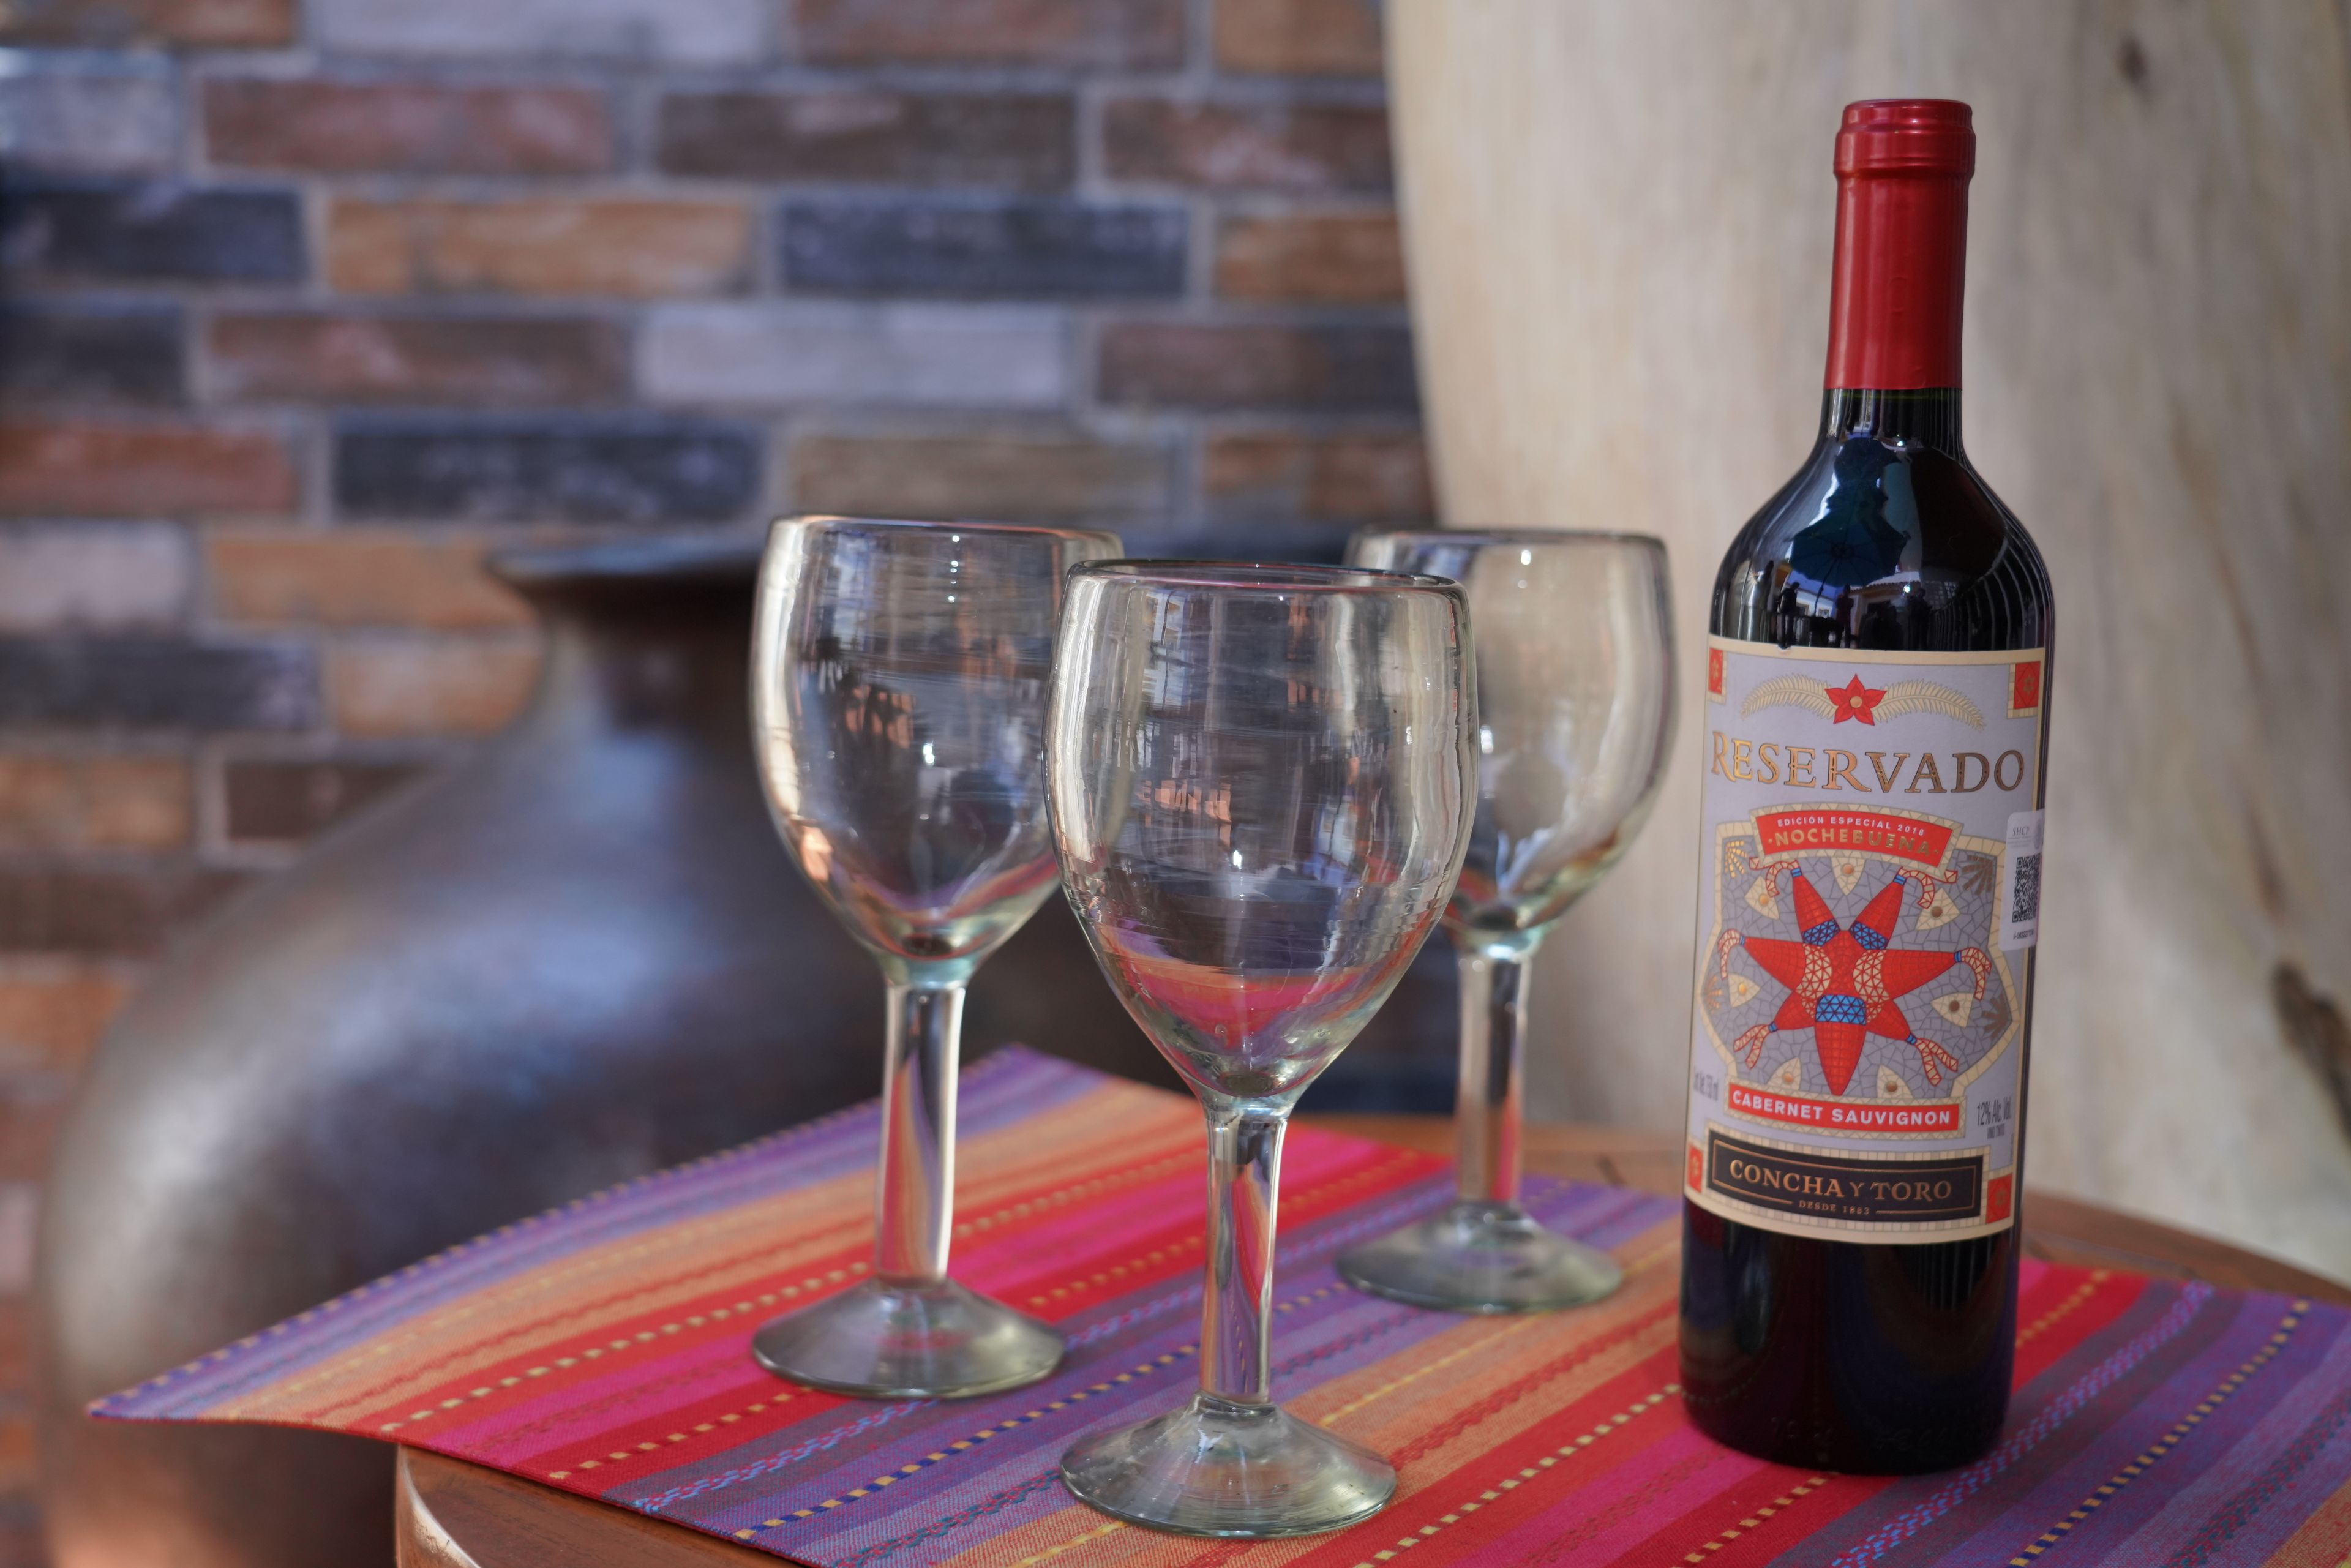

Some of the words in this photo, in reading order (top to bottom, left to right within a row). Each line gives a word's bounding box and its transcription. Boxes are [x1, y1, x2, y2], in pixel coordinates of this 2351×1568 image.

[1711, 731, 2025, 794] RESERVADO
[1777, 815, 1824, 827] EDICIÓN
[1831, 816, 1891, 830] ESPECIAL
[1897, 823, 1924, 836] 2018
[1774, 828, 1930, 856] NOCHEBUENA
[1733, 1090, 1823, 1120] CABERNET
[1831, 1108, 1951, 1125] SAUVIGNON
[1730, 1159, 1845, 1198] CONCHA
[1849, 1181, 1865, 1198] Y
[1869, 1180, 1952, 1202] TORO
[1799, 1199, 1837, 1212] DESDE
